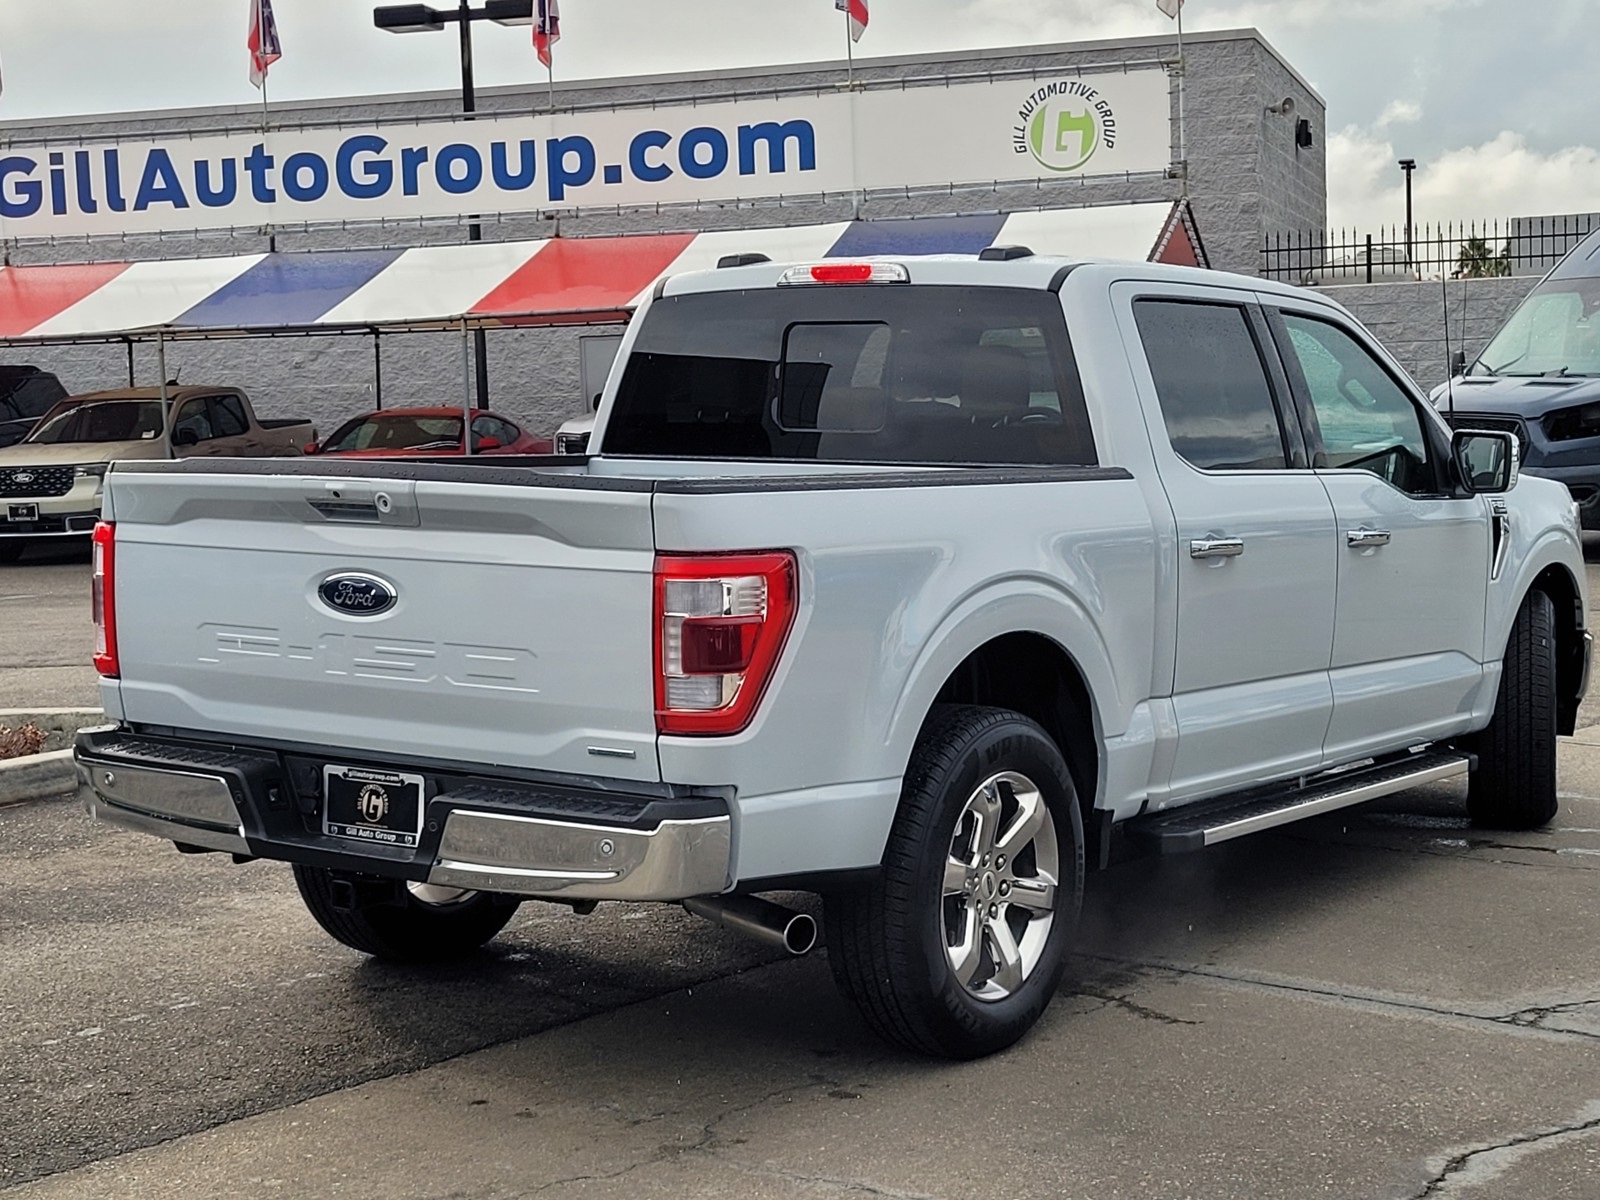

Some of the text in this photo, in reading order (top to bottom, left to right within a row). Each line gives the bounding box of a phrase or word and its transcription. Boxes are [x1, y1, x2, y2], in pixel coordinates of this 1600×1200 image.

[1012, 81, 1116, 154] GILL AUTOMOTIVE GROUP
[0, 119, 816, 218] GillAutoGroup.com
[334, 580, 377, 607] Ford
[345, 827, 358, 836] Gill
[358, 829, 374, 839] Auto
[375, 831, 397, 842] Group
